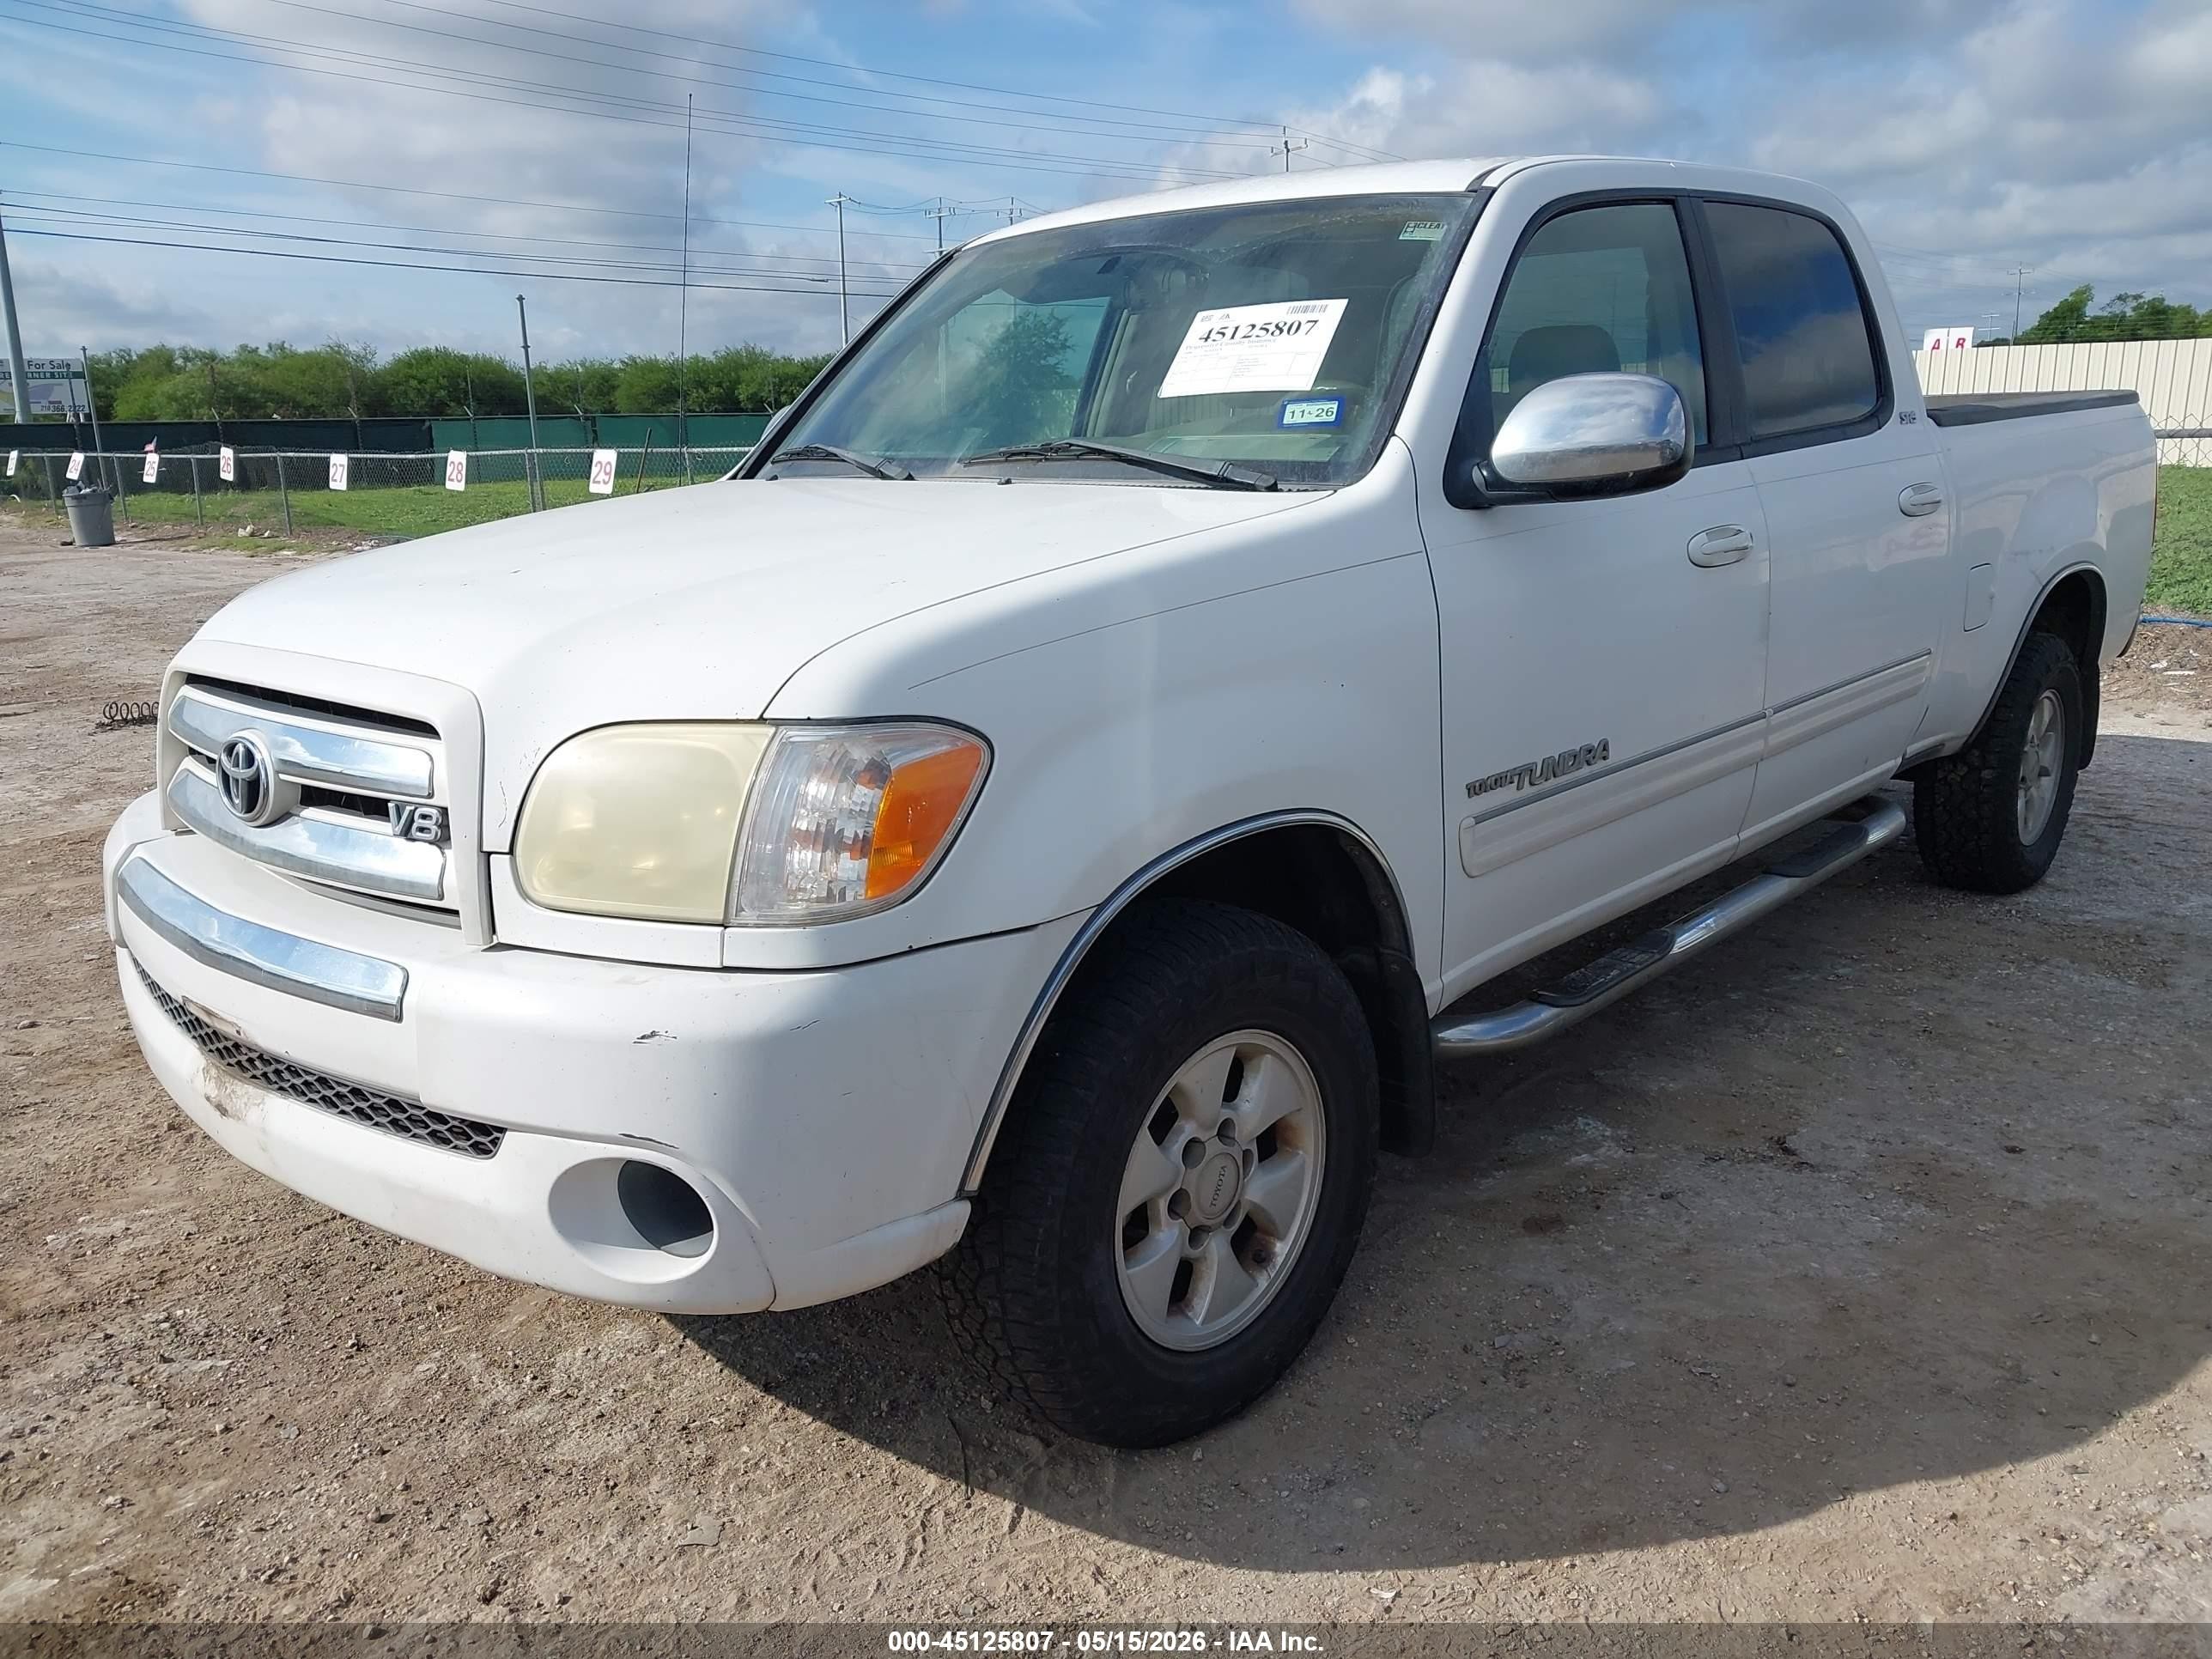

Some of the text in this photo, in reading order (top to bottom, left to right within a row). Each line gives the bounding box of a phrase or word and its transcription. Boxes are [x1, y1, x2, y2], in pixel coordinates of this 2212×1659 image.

[1199, 319, 1319, 343] 45125807
[1931, 338, 1941, 349] A
[27, 361, 46, 370] For
[1315, 407, 1335, 417] 26
[69, 459, 81, 474] 24
[146, 460, 156, 477] 25
[221, 455, 232, 474] 26
[331, 463, 345, 483] 27
[447, 460, 464, 483] 28
[592, 460, 613, 485] 29
[1466, 738, 1610, 799] TOYOTA TUNDRA
[387, 801, 442, 842] V8
[1209, 1165, 1227, 1208] TOYOTA
